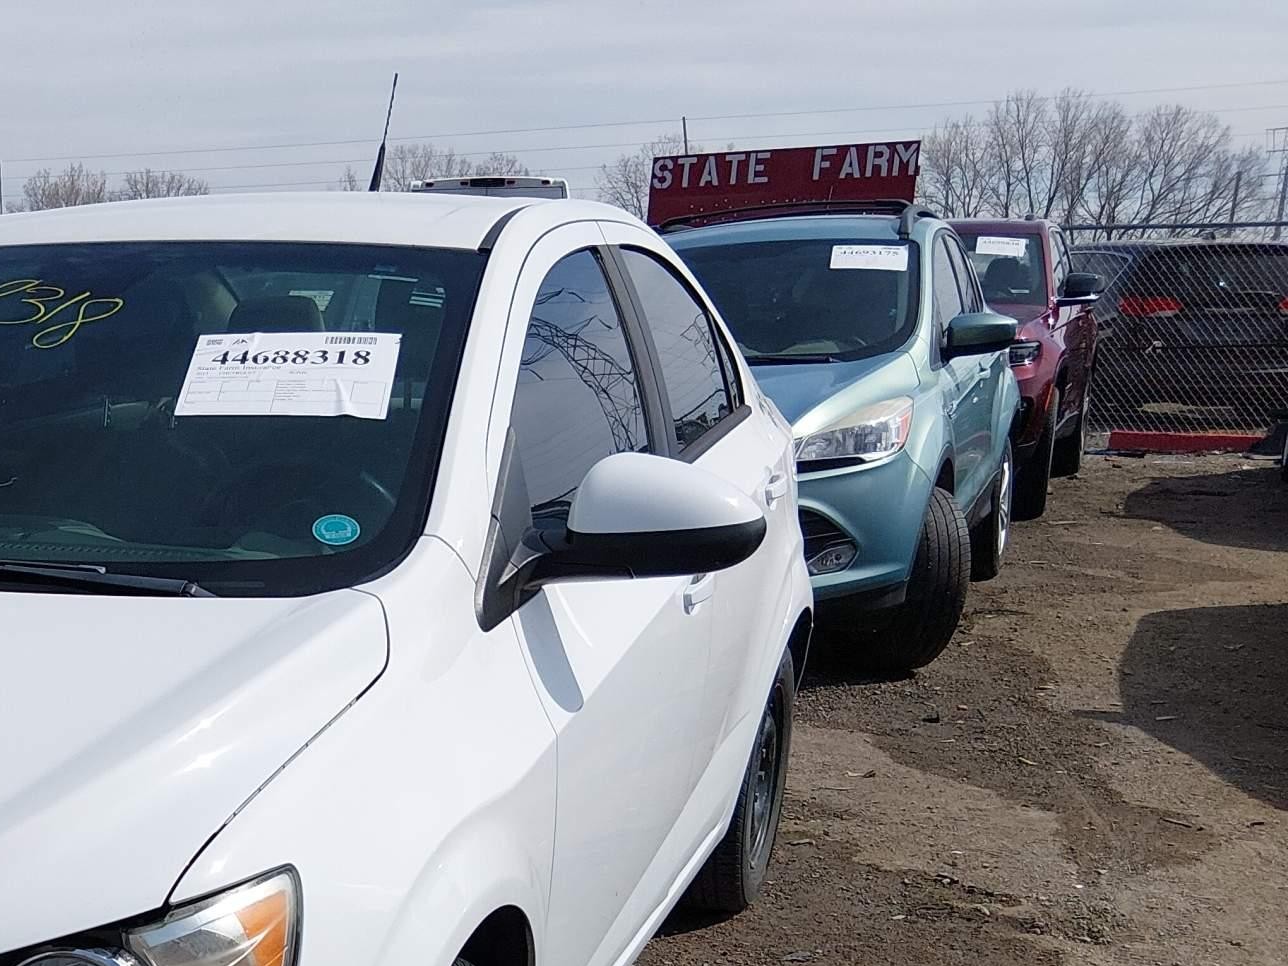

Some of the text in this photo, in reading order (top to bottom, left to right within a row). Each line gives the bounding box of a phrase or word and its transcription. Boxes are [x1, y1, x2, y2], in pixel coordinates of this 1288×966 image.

[652, 143, 919, 189] STATE FARM
[211, 349, 372, 366] 44688318
